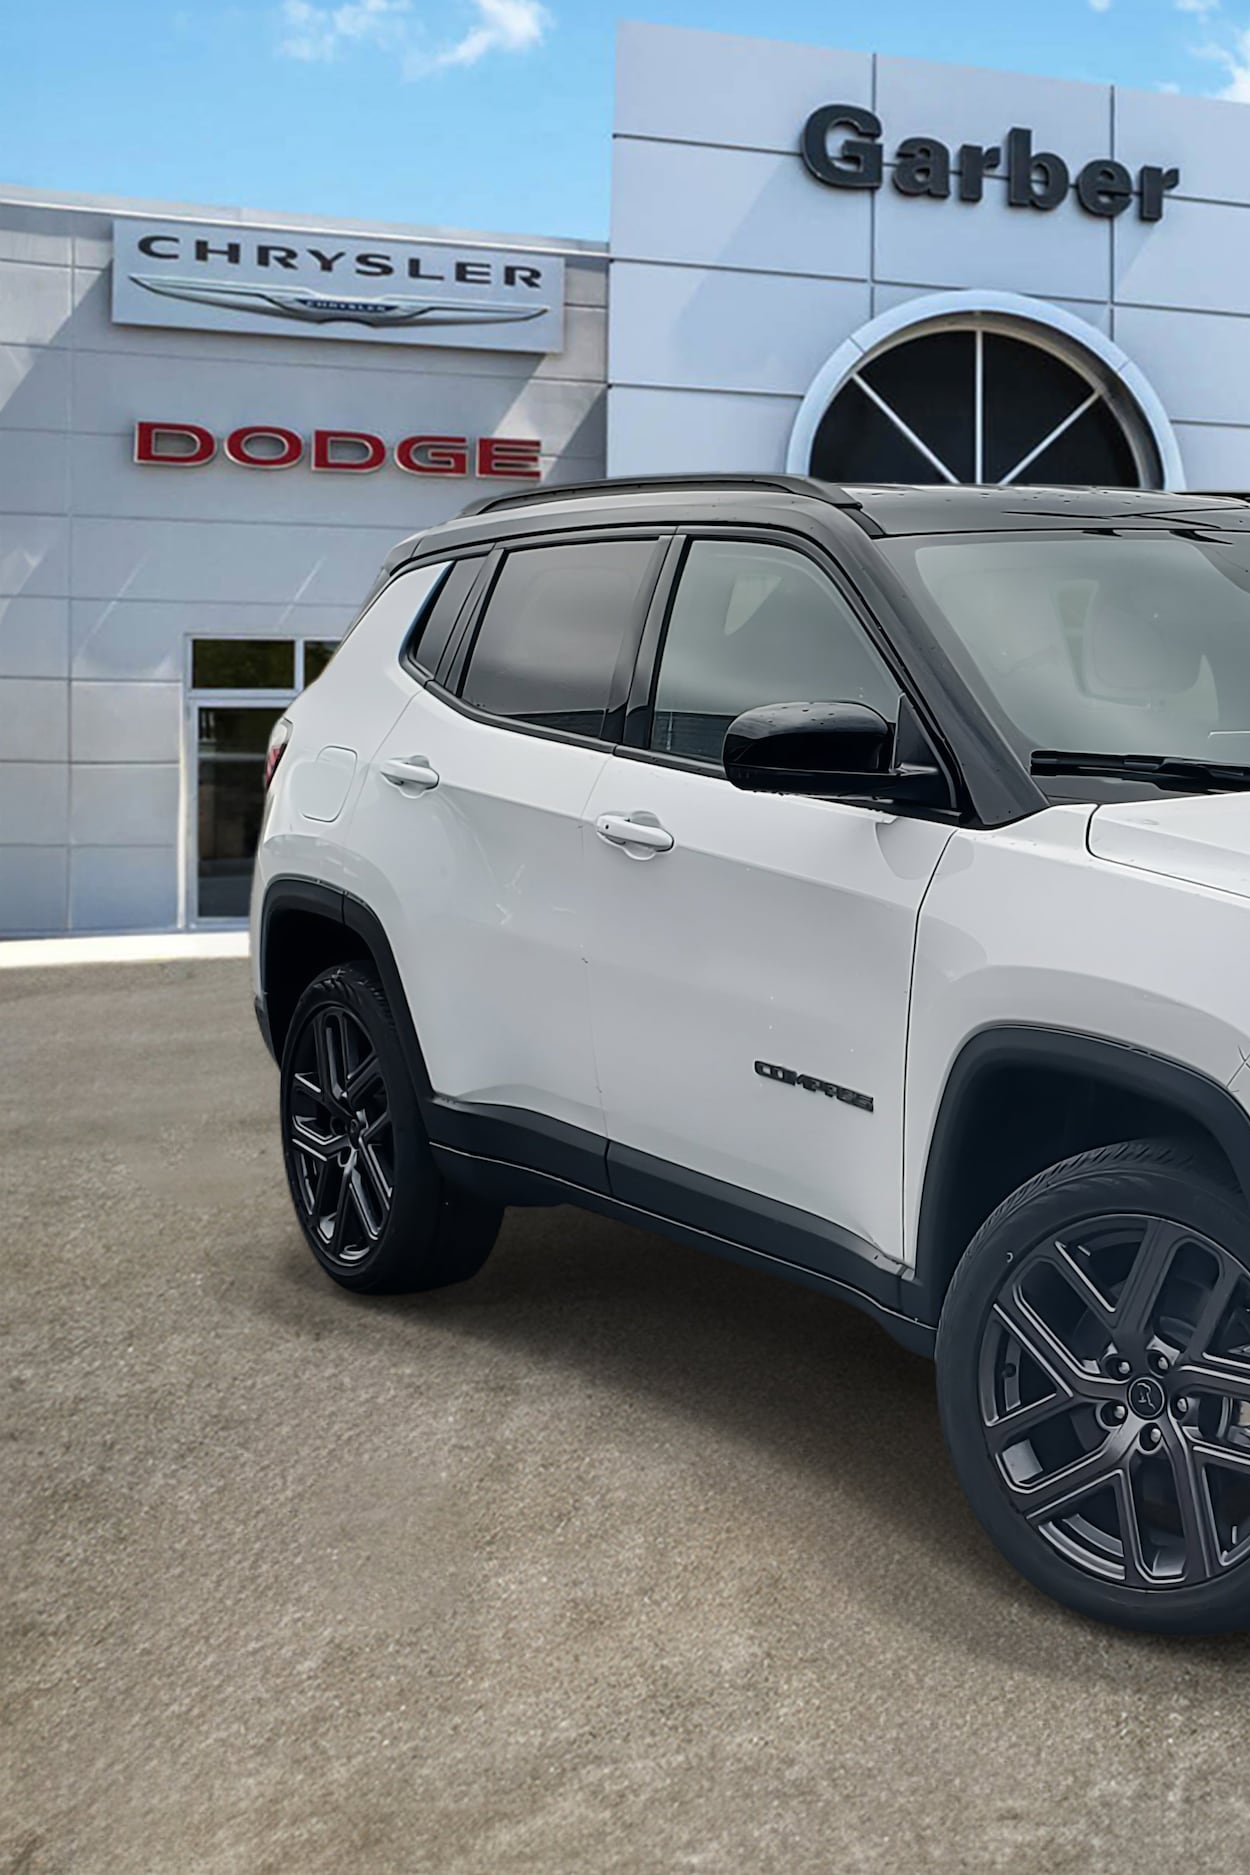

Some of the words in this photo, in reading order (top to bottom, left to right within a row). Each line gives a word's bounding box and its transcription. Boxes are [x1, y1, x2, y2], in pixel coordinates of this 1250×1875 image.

[801, 104, 1181, 222] Garber
[137, 235, 543, 289] CHRYSLER
[134, 421, 542, 479] DODGE
